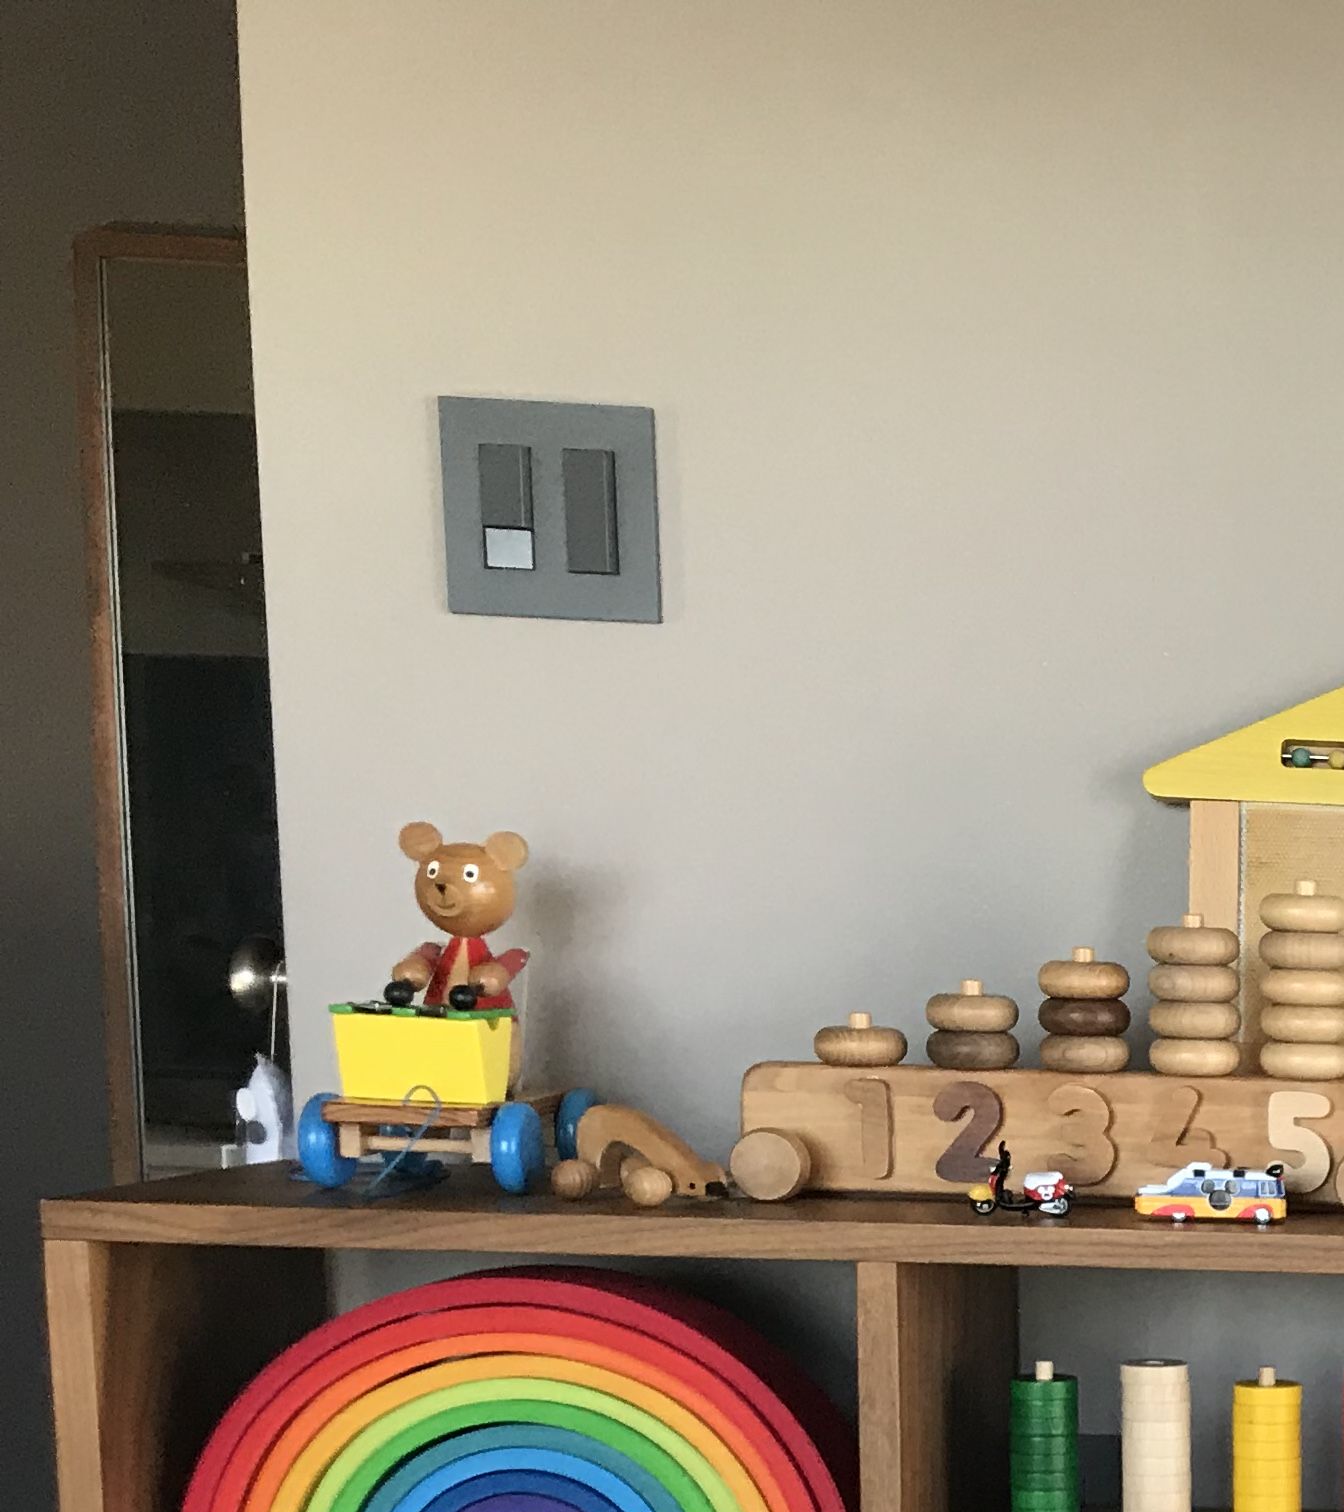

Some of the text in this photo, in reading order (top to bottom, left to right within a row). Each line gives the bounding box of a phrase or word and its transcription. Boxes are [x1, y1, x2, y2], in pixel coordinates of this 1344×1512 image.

[843, 1077, 893, 1180] 1
[932, 1081, 1005, 1183] 2
[1047, 1083, 1117, 1186] 3
[1267, 1090, 1332, 1194] 5
